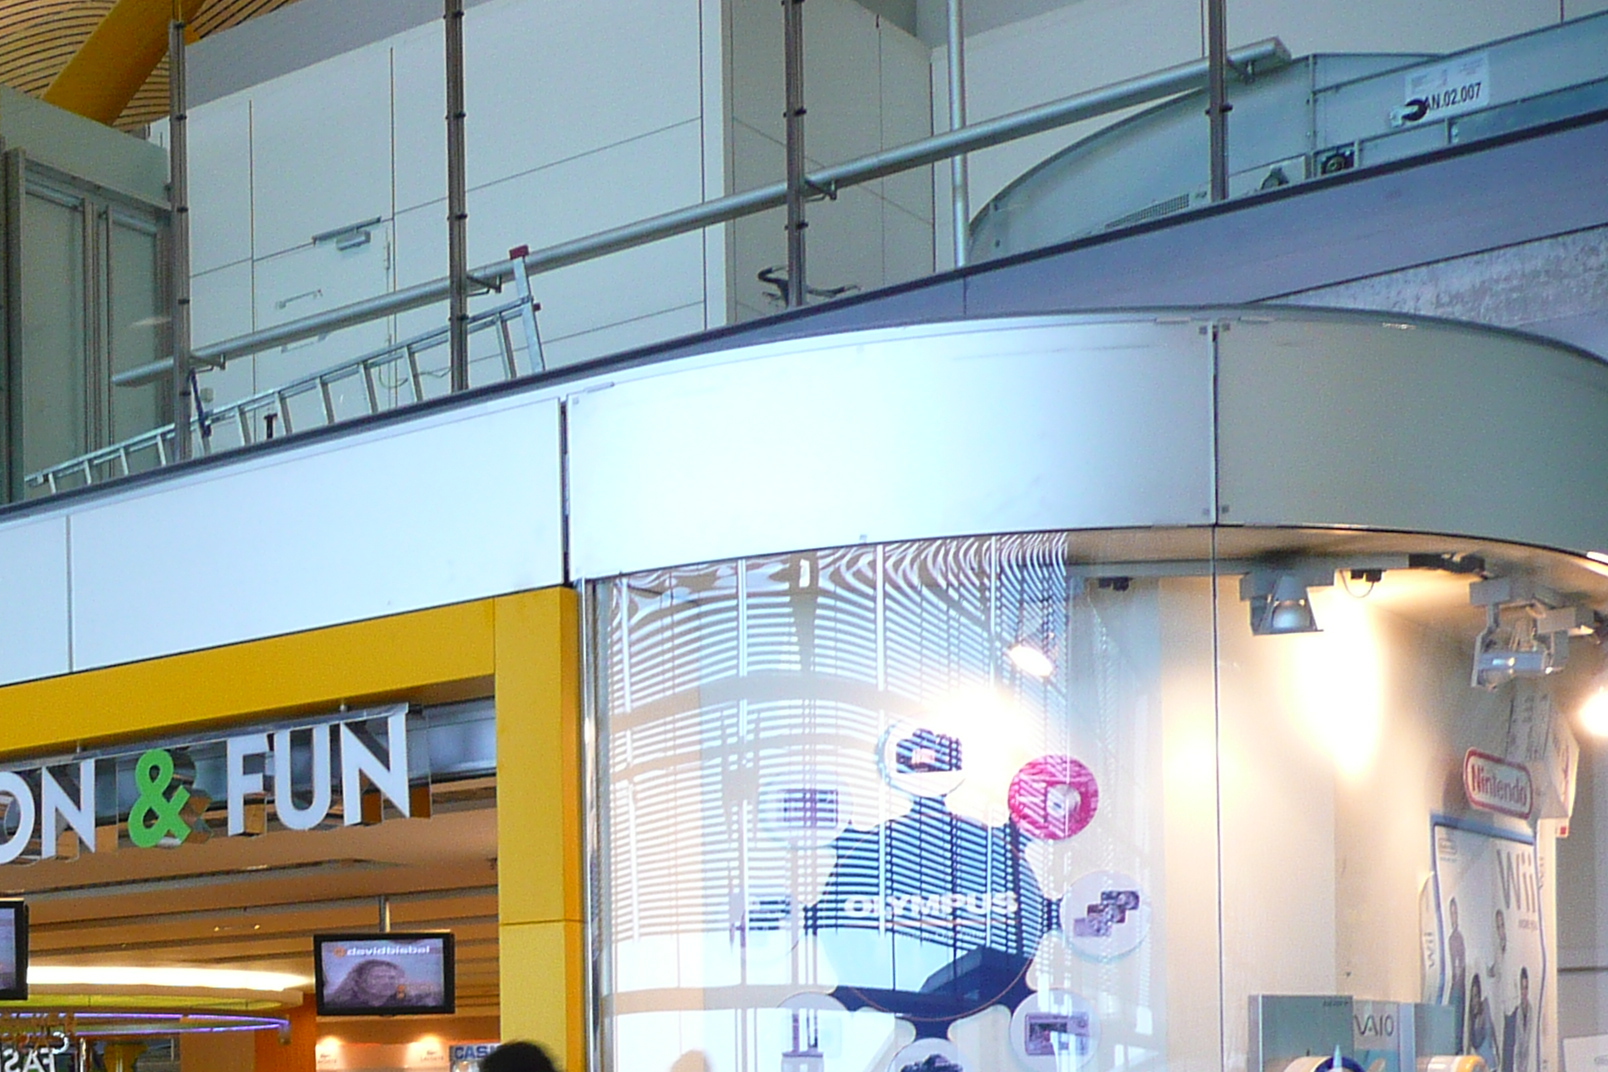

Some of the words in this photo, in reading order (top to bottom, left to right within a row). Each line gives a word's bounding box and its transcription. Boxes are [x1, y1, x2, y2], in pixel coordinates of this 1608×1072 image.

[128, 748, 191, 849] &
[227, 702, 410, 837] FUN
[1471, 763, 1529, 807] Nintendo
[1496, 849, 1536, 913] Wii
[844, 891, 1019, 918] OLYMPUS
[1354, 1014, 1394, 1037] VAIO
[454, 1045, 496, 1060] CAS
